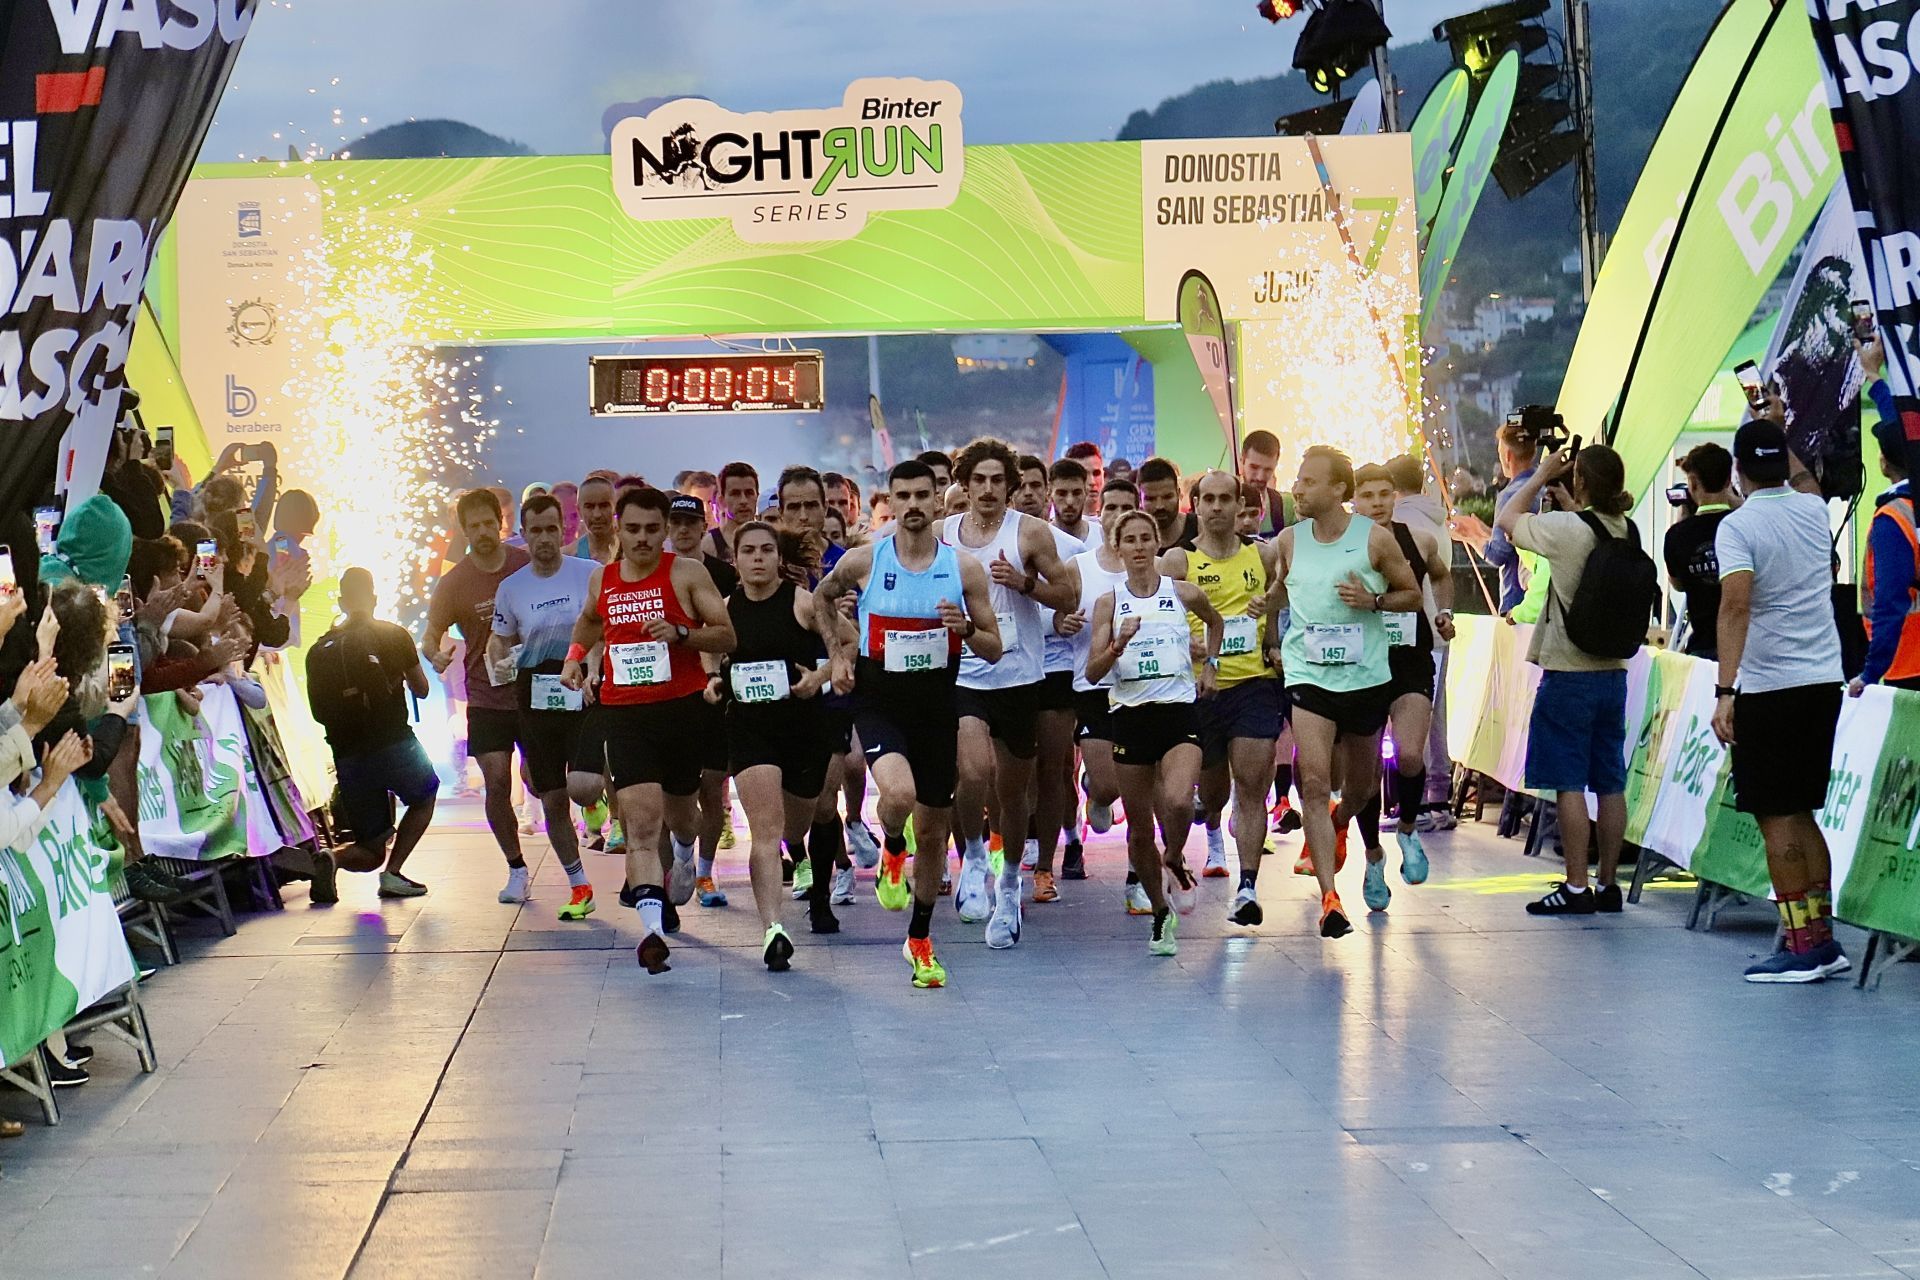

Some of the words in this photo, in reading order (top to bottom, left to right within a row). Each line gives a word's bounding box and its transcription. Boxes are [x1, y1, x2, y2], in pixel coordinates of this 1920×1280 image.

[862, 97, 942, 120] Binter
[1164, 152, 1281, 183] DONOSTIA
[752, 203, 848, 222] SERIES
[1156, 196, 1205, 225] SAN
[646, 366, 795, 402] 0:00:04
[226, 421, 282, 434] berabera
[671, 500, 697, 510] HOKA
[1197, 574, 1221, 583] INDO
[618, 587, 662, 602] GENERALI
[608, 599, 653, 616] GENÈVE
[1159, 599, 1174, 609] PA
[608, 610, 665, 626] MARATHON
[1222, 636, 1246, 650] 1462
[903, 653, 932, 668] 1534
[1321, 646, 1347, 660] 1457
[627, 665, 654, 681] 1355
[1138, 659, 1159, 674] F40
[745, 684, 775, 699] F1153
[547, 695, 566, 707] 834
